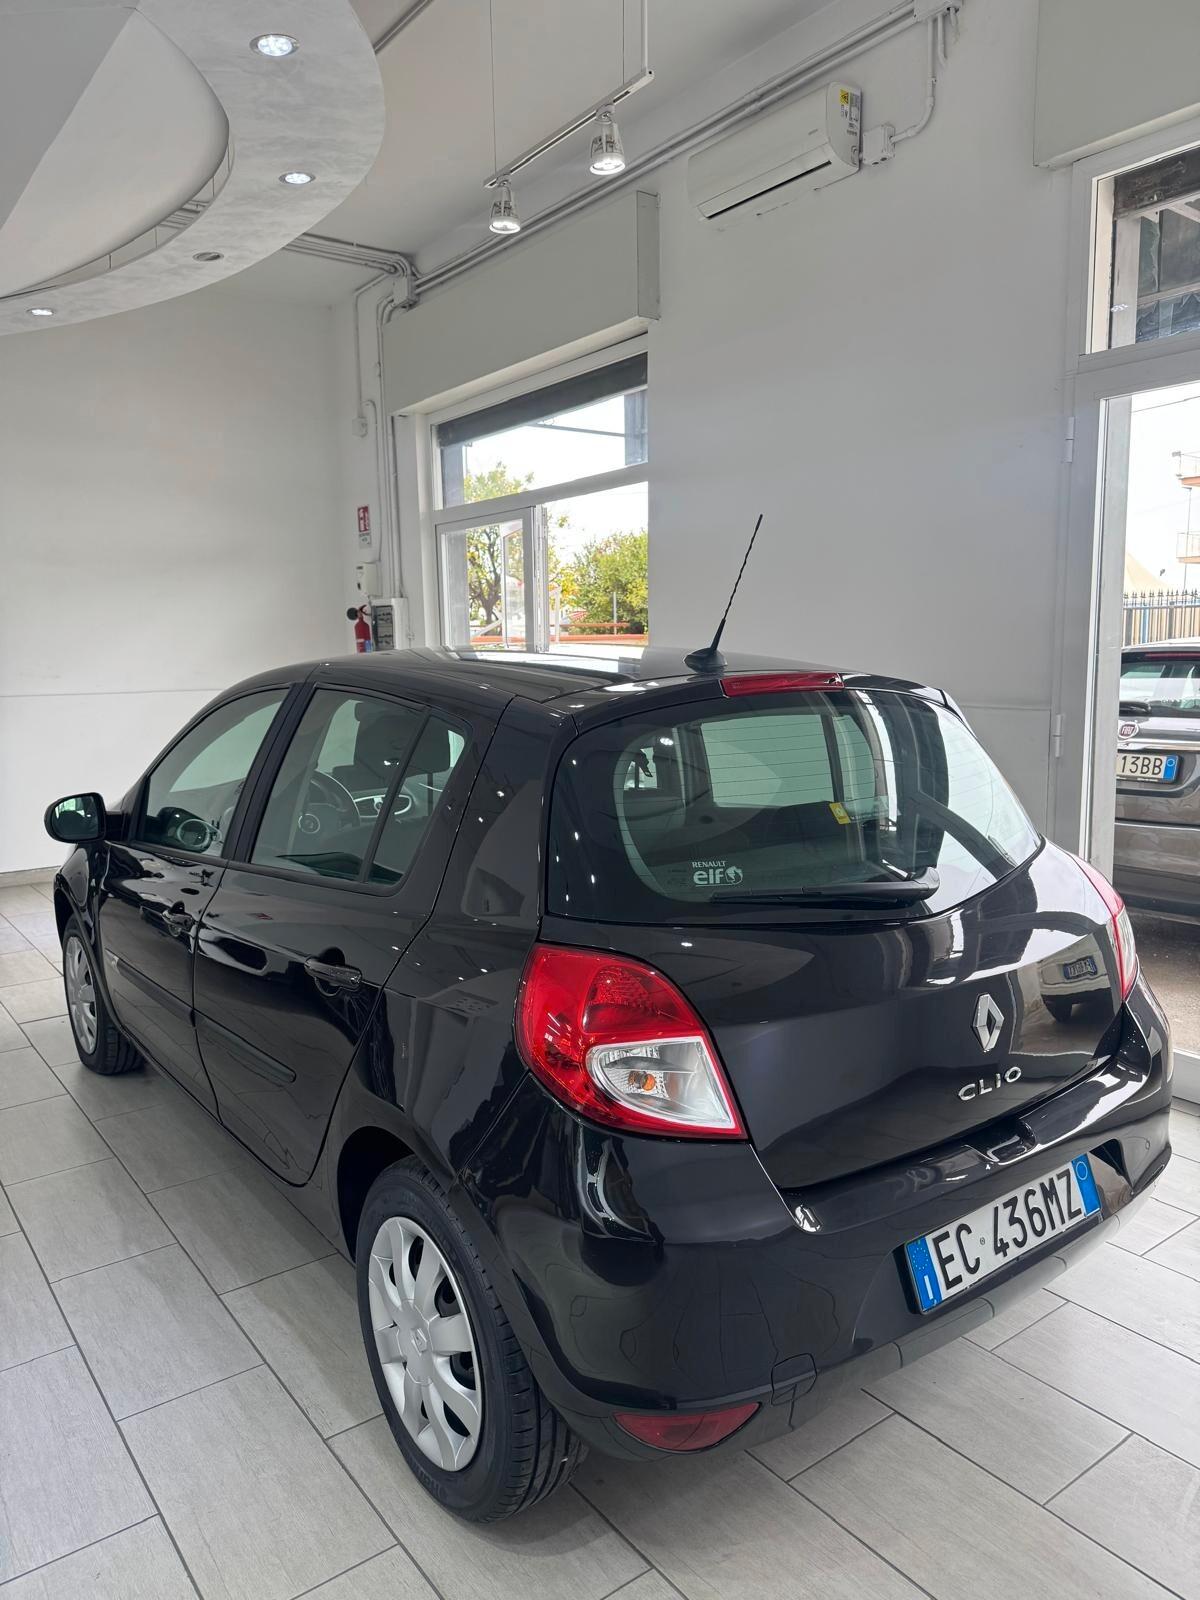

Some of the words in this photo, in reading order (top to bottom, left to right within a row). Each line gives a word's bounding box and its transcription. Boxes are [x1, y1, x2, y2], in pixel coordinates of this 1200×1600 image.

[1121, 725, 1135, 736] FIAT
[1117, 755, 1163, 776] 13BB
[692, 860, 727, 868] RENAULT
[693, 868, 724, 885] elf
[958, 1066, 1022, 1101] CLIO
[932, 1223, 981, 1291] EC
[993, 1168, 1082, 1258] 436MZ
